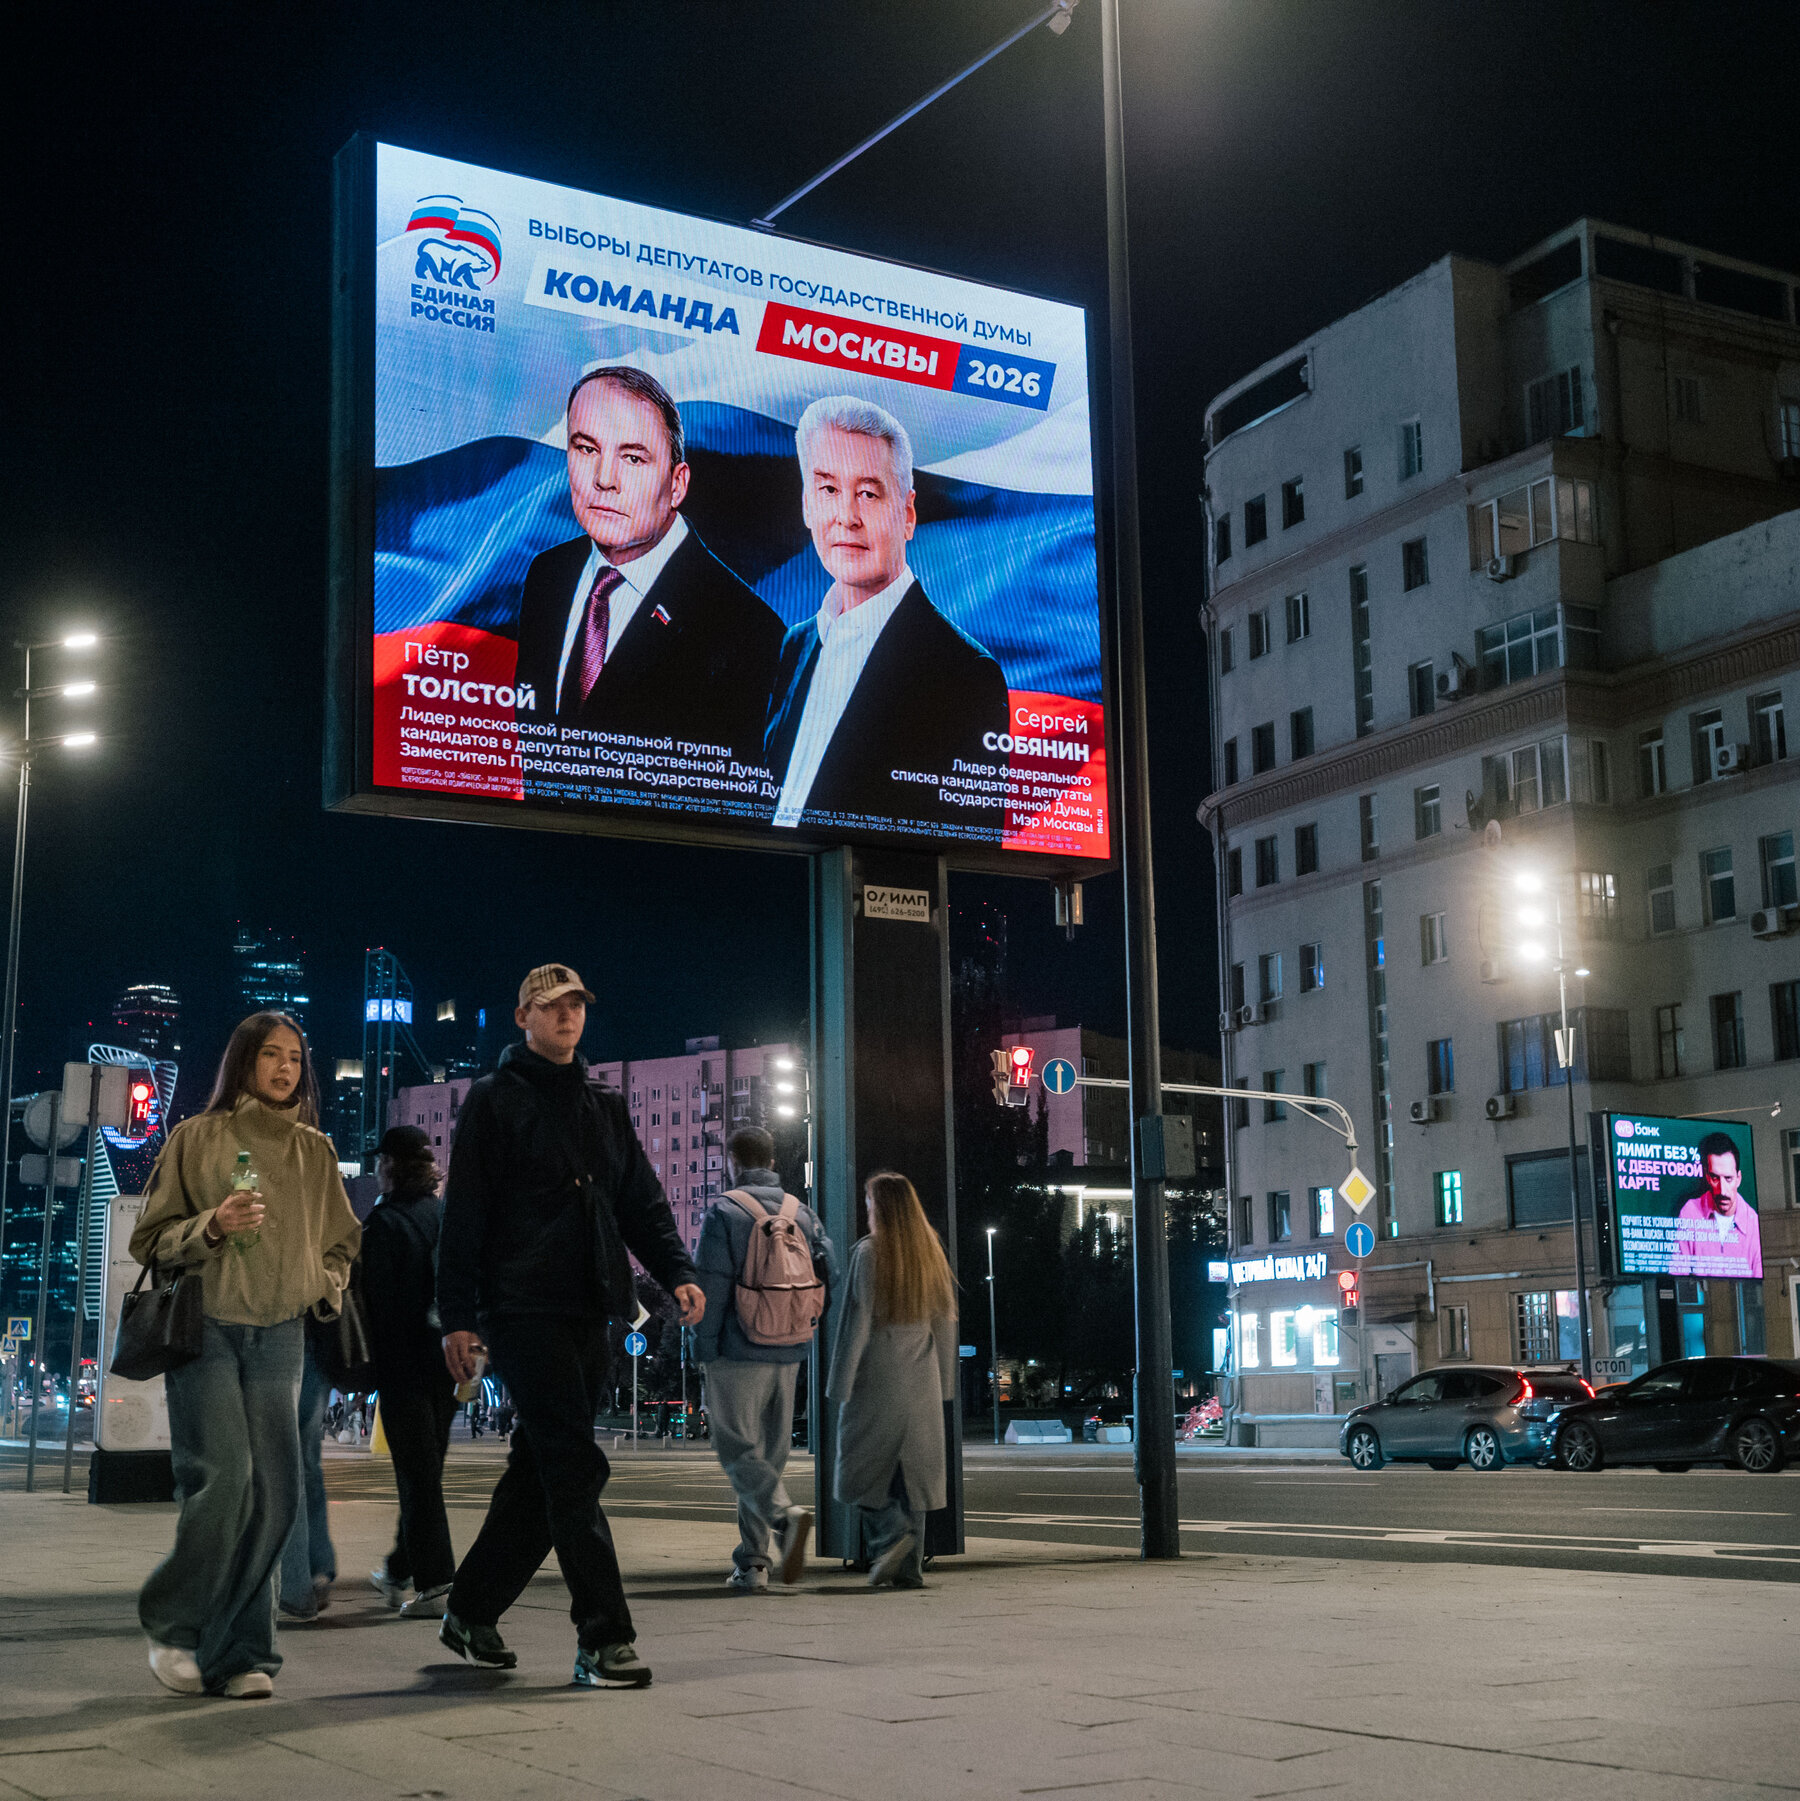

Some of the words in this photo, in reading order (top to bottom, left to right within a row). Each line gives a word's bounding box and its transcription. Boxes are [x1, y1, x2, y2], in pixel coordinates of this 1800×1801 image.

[529, 218, 630, 257] ВЫБОРЫ
[637, 244, 763, 286] ДЕПУТАТОВ
[770, 274, 968, 332] ГОСУДАРСТВЕННОЙ
[973, 320, 1031, 347] ДУМЫ
[411, 283, 495, 314] ЕДИНАЯ
[411, 302, 495, 333] РОССИЯ
[544, 269, 740, 335] КОМАНДА
[782, 320, 938, 375] МОСКВЫ
[967, 360, 1041, 396] 2026
[404, 642, 470, 673] Пётр
[402, 674, 536, 710] ТОЛСТОЙ
[400, 706, 456, 728] Лидер
[460, 715, 557, 737] московской
[561, 727, 673, 750] региональной
[677, 740, 732, 758] группы
[1015, 707, 1088, 734] Сергей
[400, 726, 498, 749] кандидатов
[502, 738, 512, 750] в
[515, 739, 591, 758] депутаты
[594, 747, 726, 774] Государственной
[729, 762, 774, 781] Думы,
[983, 731, 1090, 763] СОБЯНИН
[400, 742, 506, 767] Заместитель
[510, 754, 624, 779] Председателя
[628, 767, 758, 794] Государственной
[952, 758, 996, 777] Лидер
[999, 764, 1092, 787] федерального
[891, 770, 939, 785] списка
[942, 776, 1019, 794] кандидатов
[1022, 784, 1031, 795] в
[1032, 786, 1092, 802] депутаты
[939, 789, 1051, 813] Государственной
[1054, 802, 1093, 819] Думы,
[1012, 813, 1040, 829] Мэр
[1044, 817, 1094, 833] Москвы
[1635, 1122, 1660, 1137] банк
[1616, 1142, 1663, 1158] ЛИМИТ
[1664, 1146, 1688, 1161] БЕЗ
[1689, 1147, 1701, 1161] %
[1617, 1159, 1627, 1173] К
[1629, 1160, 1703, 1178] ДЕБЕТОВОЙ
[1618, 1175, 1660, 1191] КАРТЕ
[1595, 1360, 1626, 1373] СТОП
